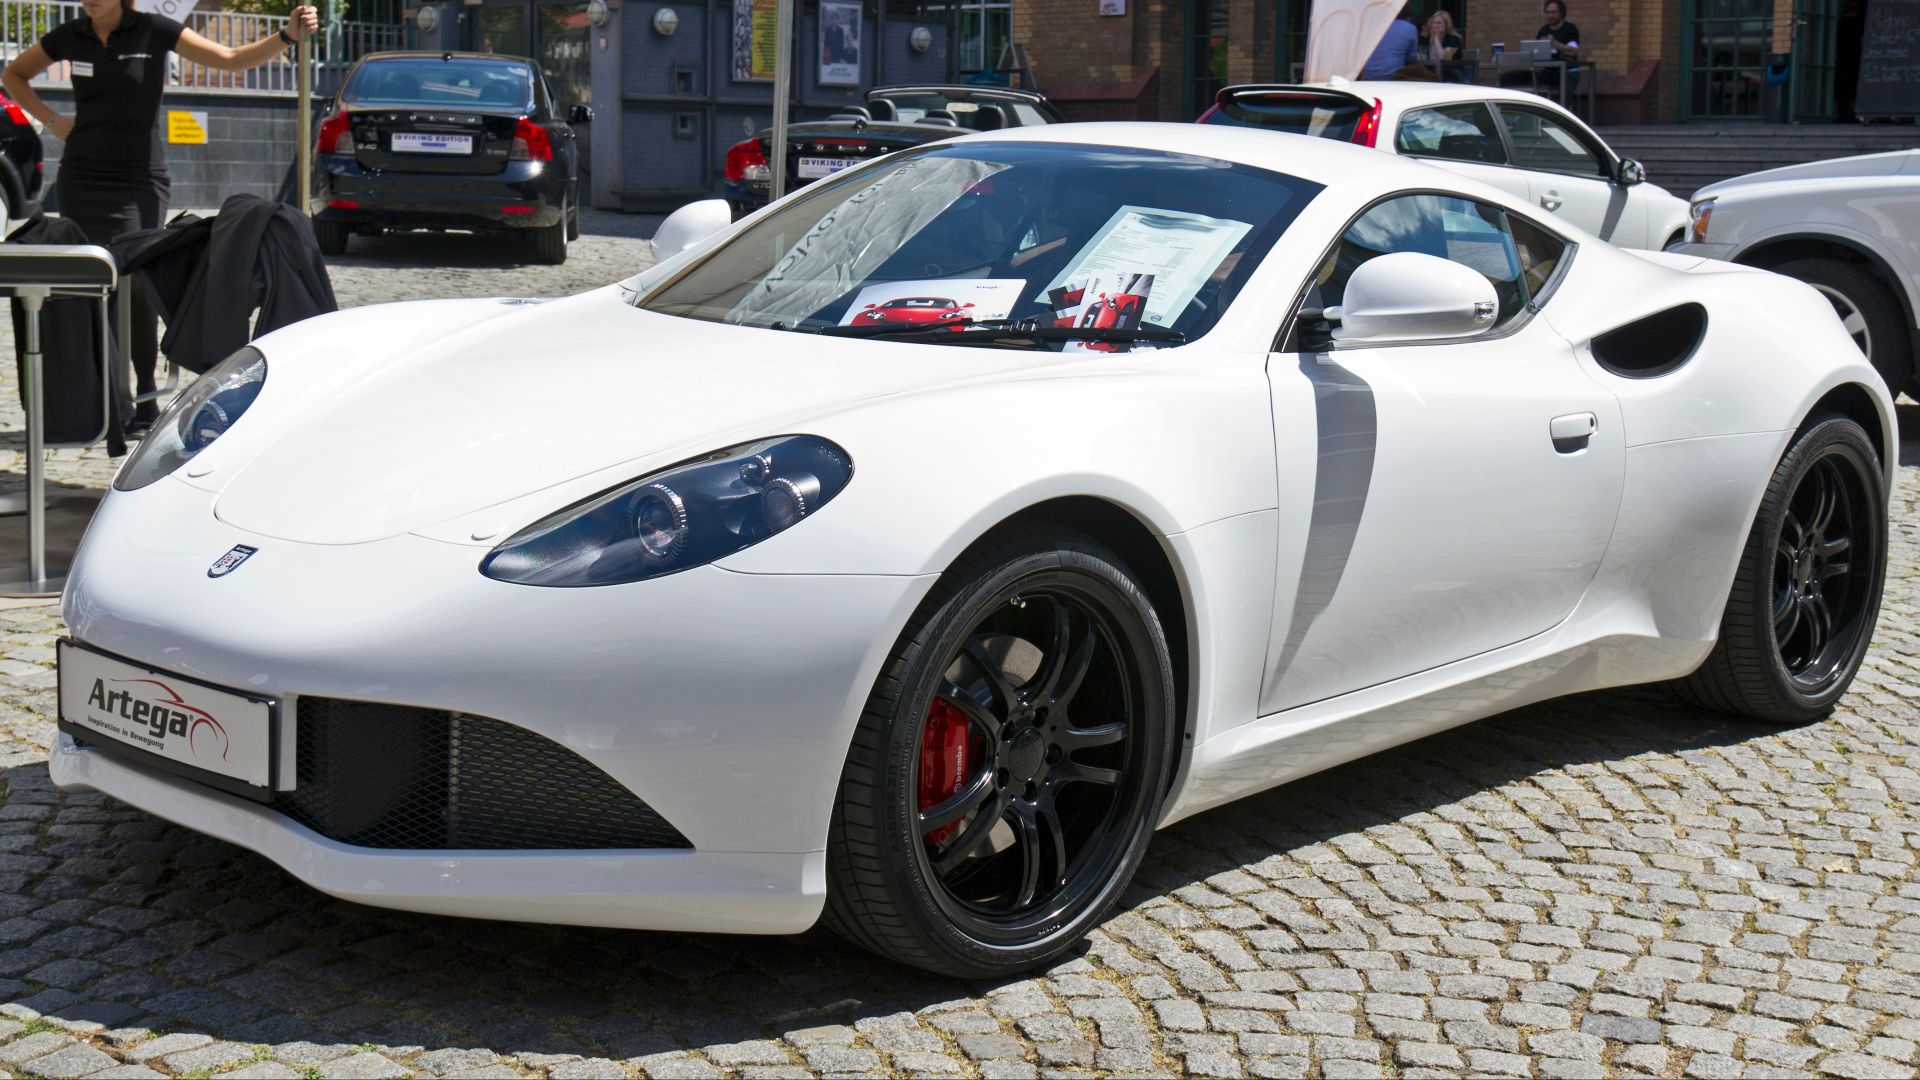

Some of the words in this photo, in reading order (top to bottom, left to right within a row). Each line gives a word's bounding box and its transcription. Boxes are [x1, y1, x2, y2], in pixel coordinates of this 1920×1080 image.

[435, 135, 470, 143] EDITION
[811, 159, 843, 167] VIKING
[87, 714, 121, 734] Inspiration
[121, 727, 129, 737] in
[129, 730, 165, 751] Bewegung
[955, 745, 963, 783] brembo
